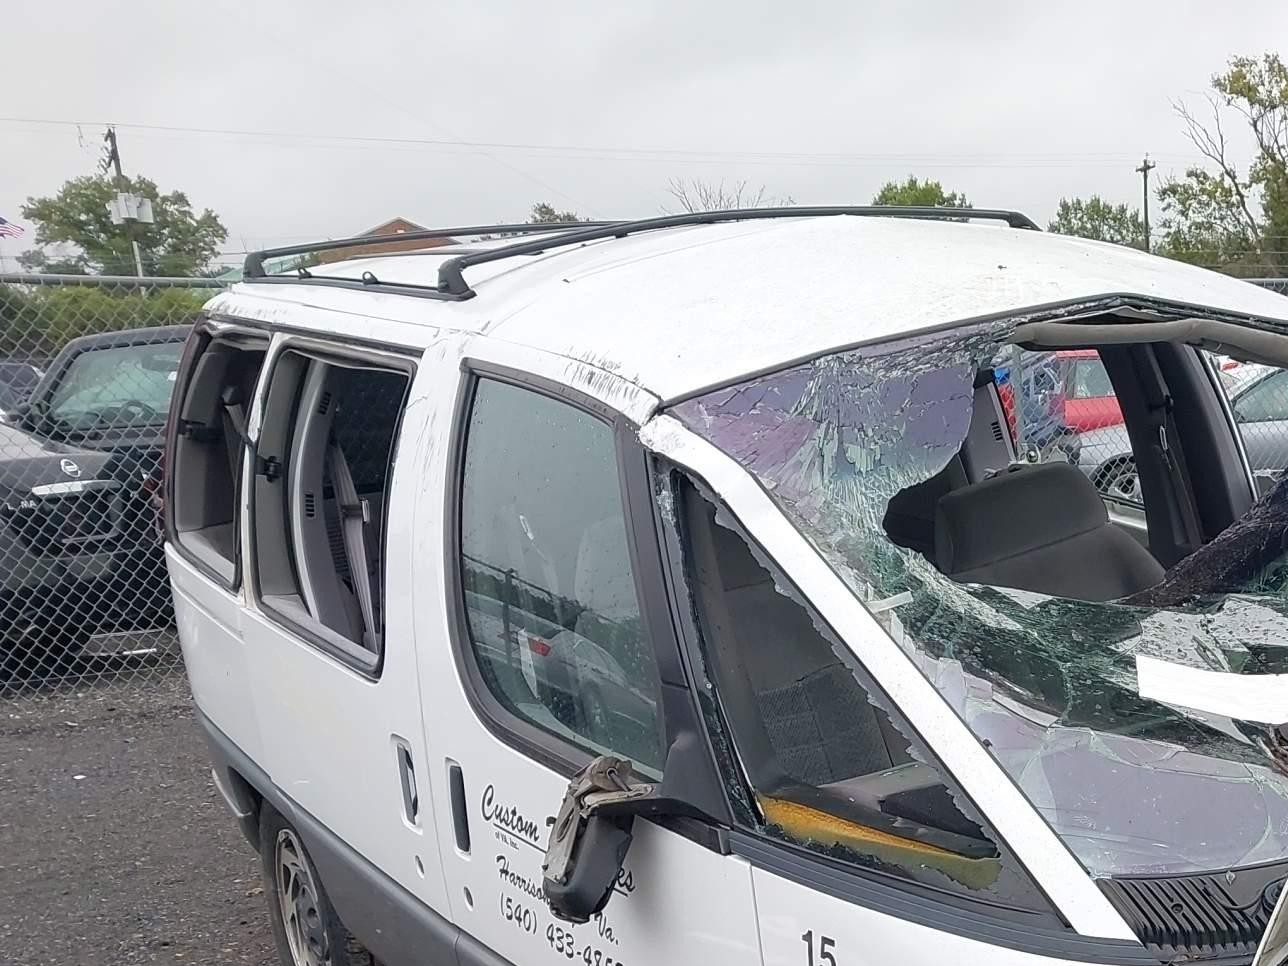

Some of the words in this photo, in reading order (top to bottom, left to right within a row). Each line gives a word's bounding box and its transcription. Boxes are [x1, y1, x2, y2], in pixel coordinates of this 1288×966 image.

[482, 784, 540, 842] Custom
[500, 893, 538, 935] (540)
[594, 911, 619, 946] Va.
